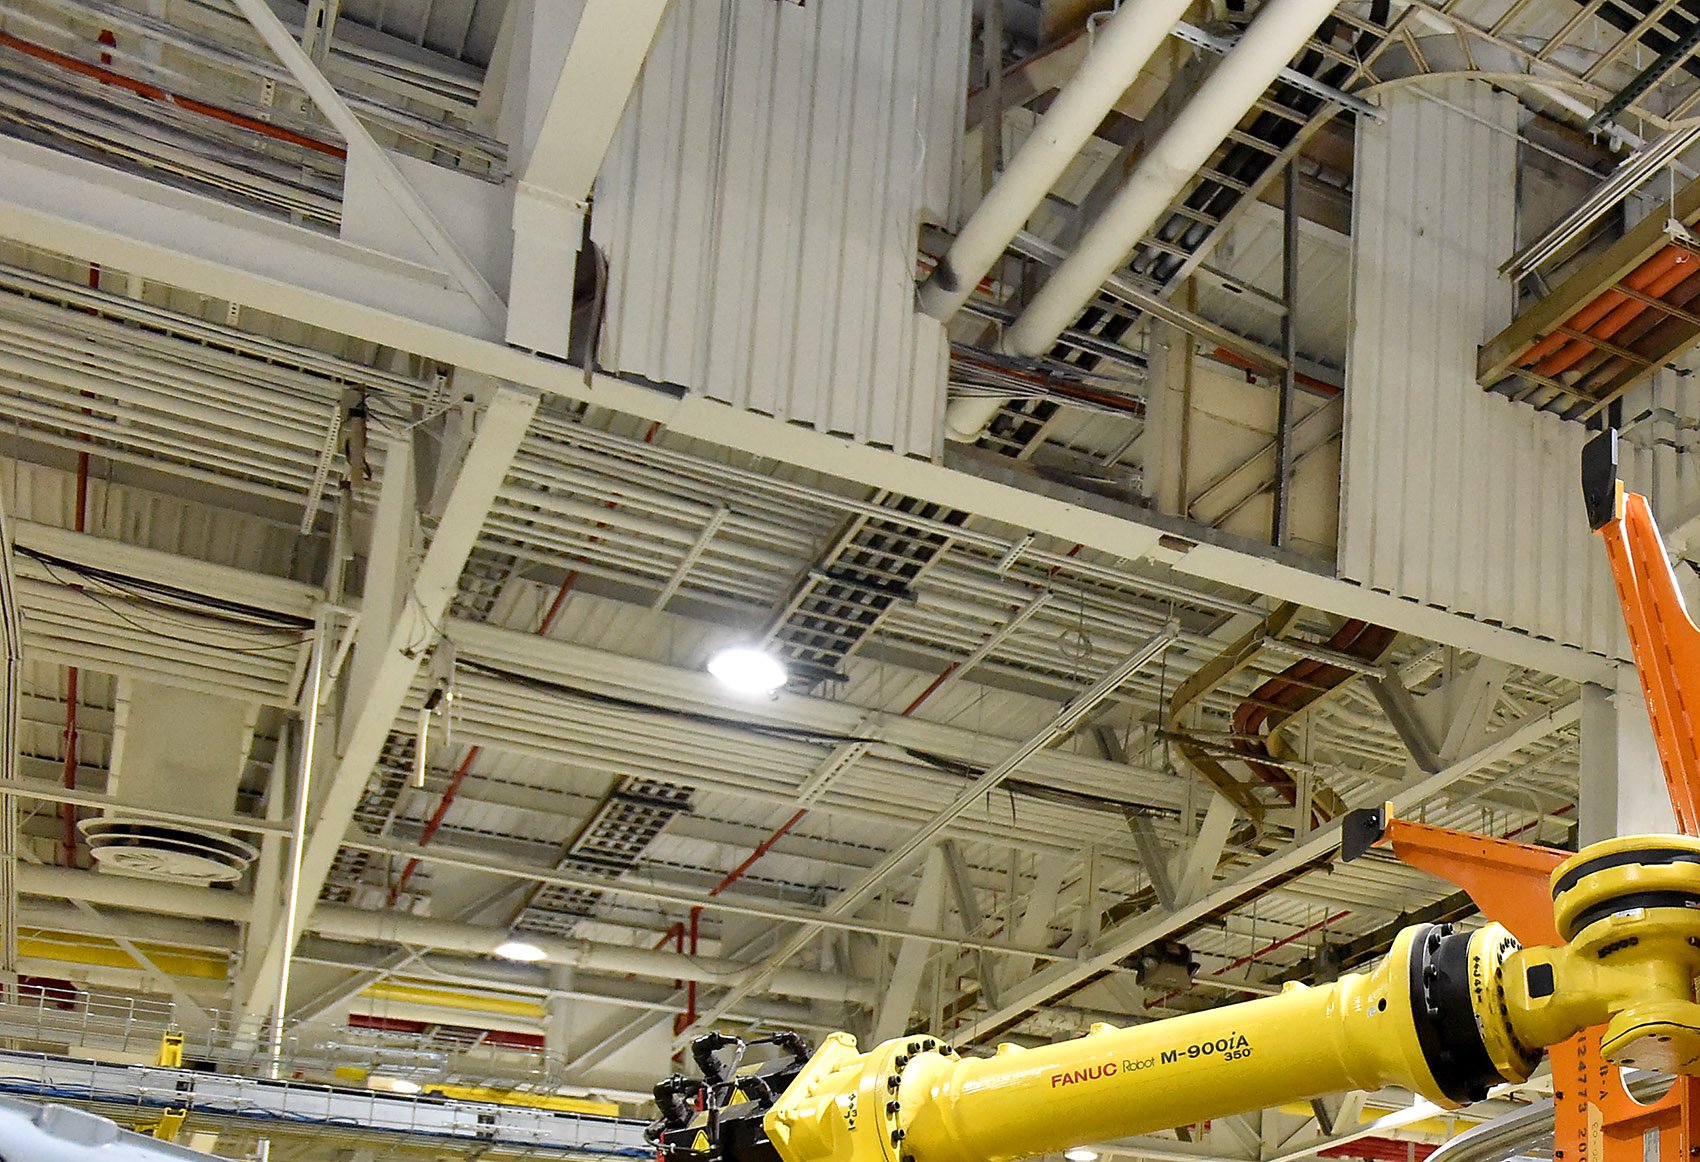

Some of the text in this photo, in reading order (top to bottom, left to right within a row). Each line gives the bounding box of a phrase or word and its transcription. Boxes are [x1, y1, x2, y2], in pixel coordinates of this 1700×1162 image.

[1051, 1031, 1250, 1088] FANUC Robot M-900iA
[1224, 1048, 1252, 1062] 350
